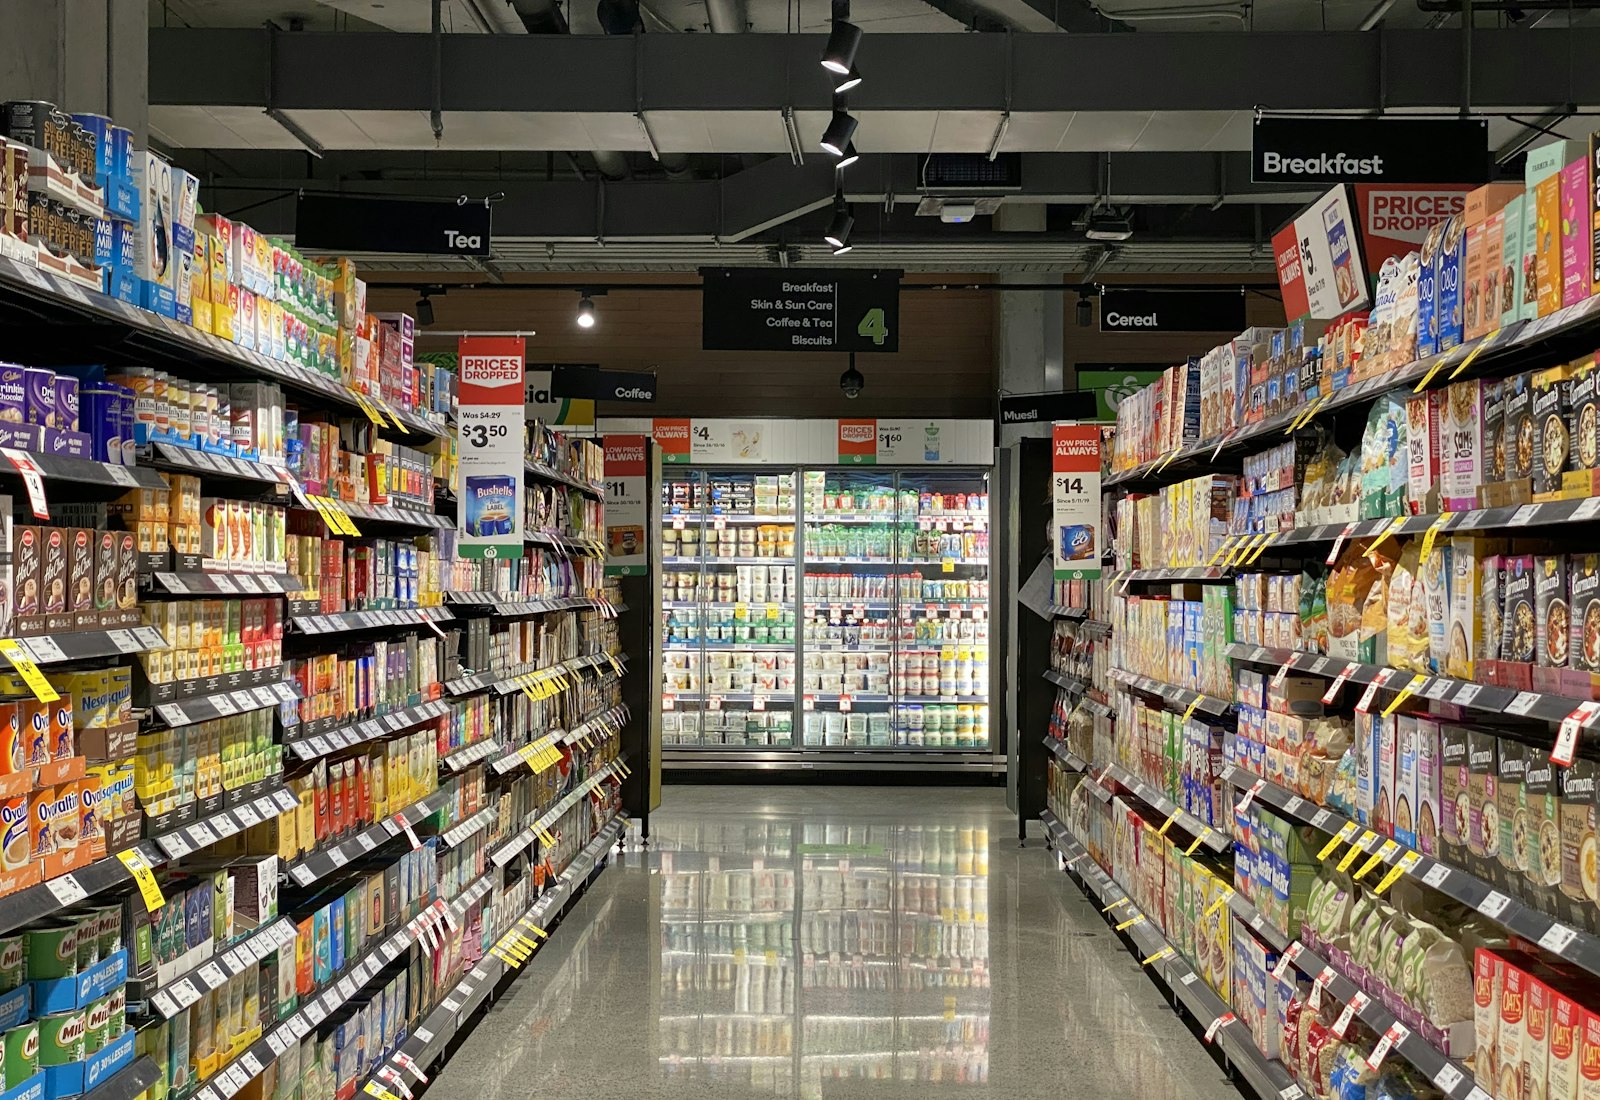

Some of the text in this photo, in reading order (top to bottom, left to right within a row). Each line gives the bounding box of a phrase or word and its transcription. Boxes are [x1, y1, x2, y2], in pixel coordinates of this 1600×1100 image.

[1264, 152, 1383, 174] Breakfast
[1373, 196, 1465, 216] PRICES
[444, 230, 481, 248] Tea
[1300, 237, 1314, 275] $5
[782, 282, 833, 293] Breakfast
[751, 300, 833, 310] Skin & Sun Care
[766, 317, 833, 328] Coffee & Tea
[858, 308, 888, 345] 4
[1106, 312, 1158, 327] Cereal
[792, 335, 833, 345] Biscuits
[465, 359, 518, 370] PRICES
[464, 371, 518, 379] DROPPED
[615, 387, 652, 399] Coffee
[1533, 384, 1558, 416] Carman's
[480, 411, 501, 419] $4.29
[1004, 409, 1038, 421] Muesli
[693, 426, 709, 440] $4
[1075, 439, 1098, 447] PRICE
[605, 453, 644, 462] ALWAYS
[1056, 447, 1098, 456] ALWAYS
[477, 485, 513, 498] Bushells
[606, 481, 625, 497] $11
[1056, 478, 1084, 494] $14
[1572, 570, 1598, 595] Carman's
[1442, 738, 1465, 758] Carman's
[1470, 747, 1492, 765] Carman's
[1526, 764, 1551, 785] Carman's
[1476, 976, 1490, 997] OATS
[1503, 991, 1521, 1014] OATS
[1528, 1005, 1544, 1028] OATS
[1552, 1023, 1571, 1049] OATS
